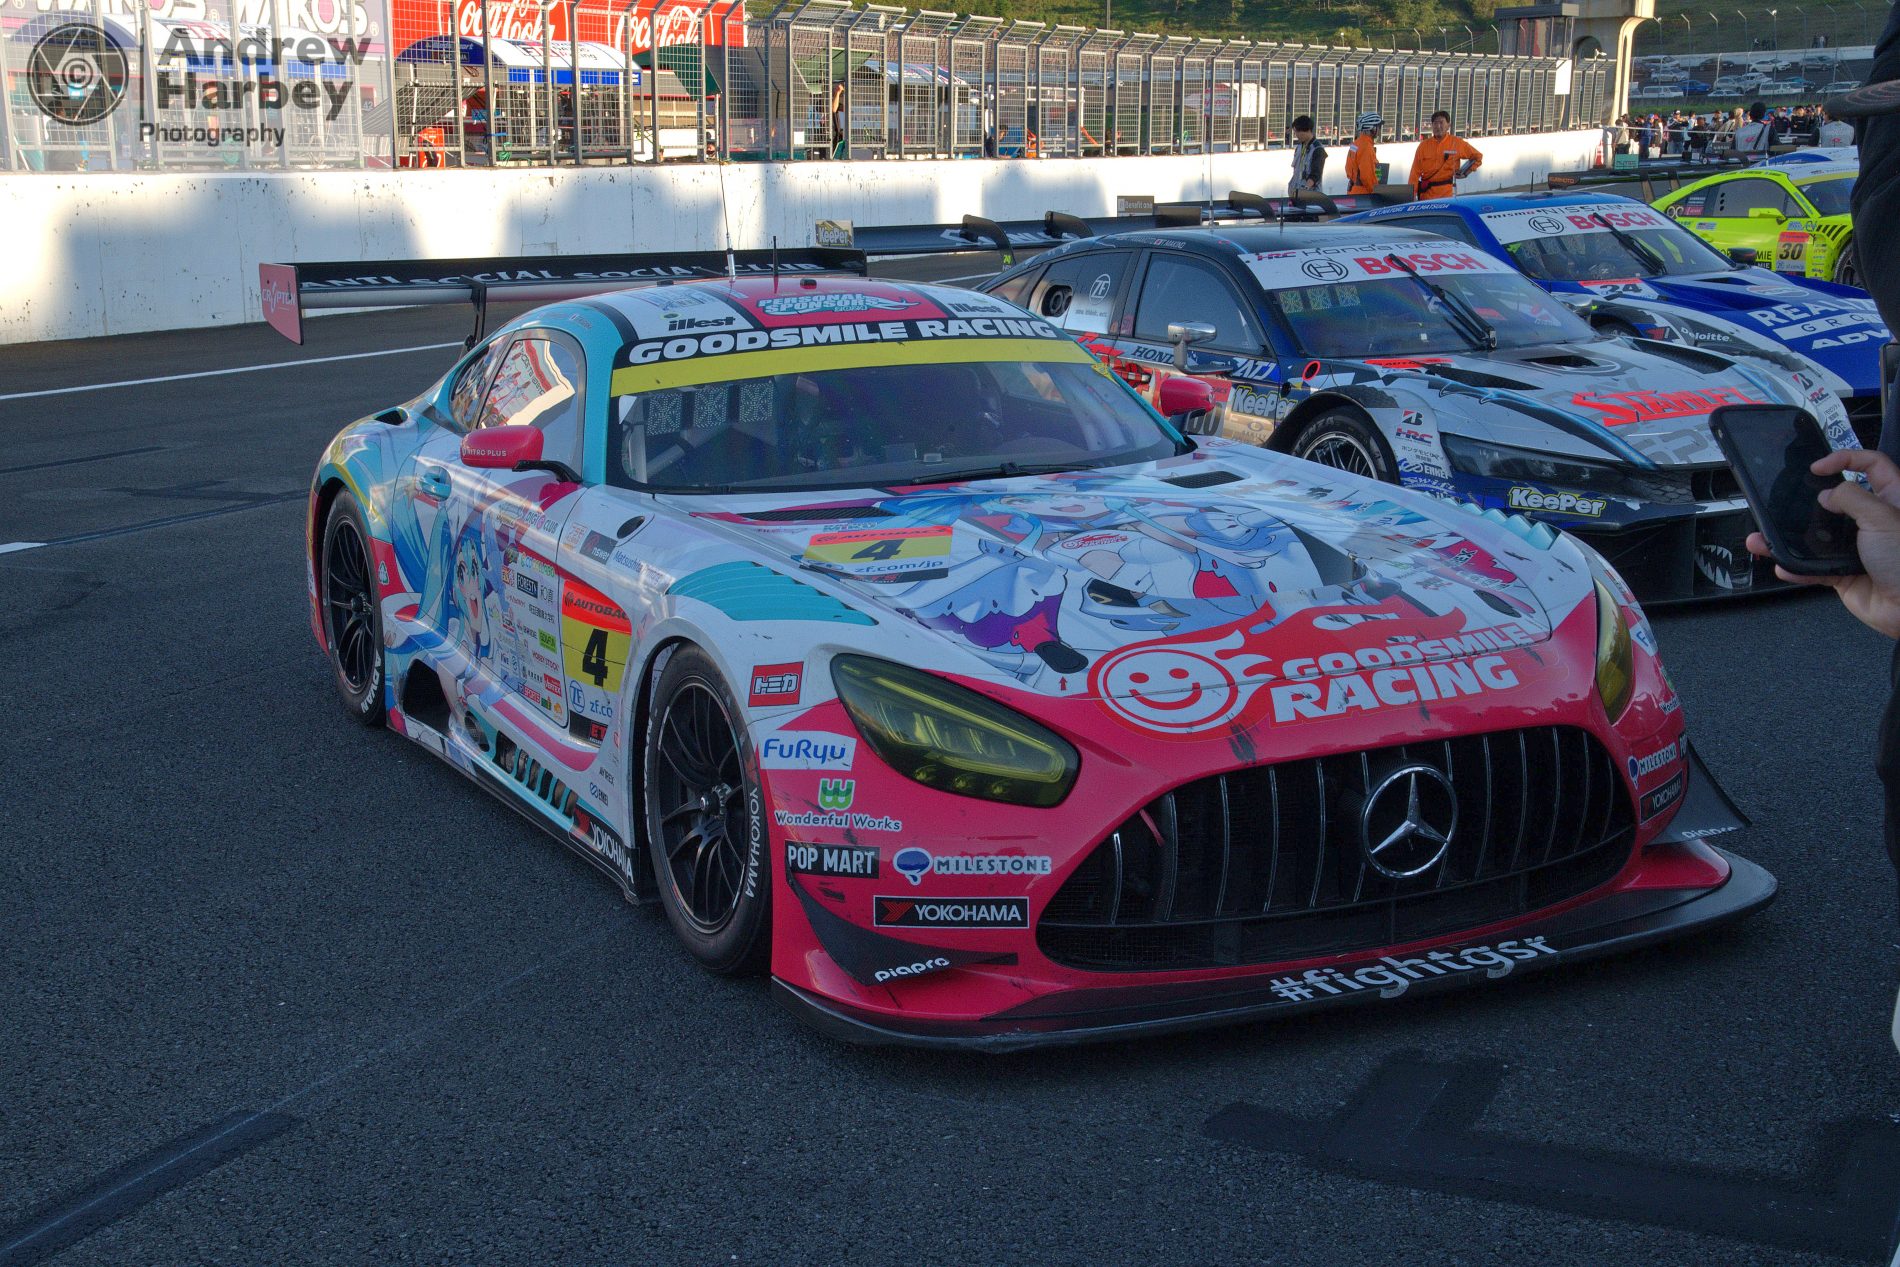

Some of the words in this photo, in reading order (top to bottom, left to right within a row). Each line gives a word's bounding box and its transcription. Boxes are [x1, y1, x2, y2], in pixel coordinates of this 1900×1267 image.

[1542, 203, 1622, 215] NISSAN
[1566, 212, 1663, 230] BOSCH
[1780, 242, 1803, 261] 30
[1354, 252, 1489, 276] BOSCH
[301, 275, 400, 290] ANTI
[668, 315, 737, 331] illest
[628, 321, 910, 365] GOODSMILE
[913, 319, 1057, 341] RACING
[1812, 328, 1890, 350] ADV
[1395, 427, 1433, 445] HRC
[1508, 488, 1606, 518] KeePer
[850, 539, 907, 561] 4
[854, 560, 944, 575] zf.com/jp
[582, 628, 609, 688] 4
[1280, 622, 1540, 679] GOODSMILE
[753, 671, 799, 696] トミカ
[1268, 655, 1521, 724] RACING
[763, 738, 847, 765] FuRyu
[775, 811, 850, 829] Wonderful
[852, 814, 902, 833] Works
[590, 822, 635, 884] YOKOHAMA
[745, 787, 760, 898] YOKOHAMA
[788, 845, 818, 868] POP
[823, 847, 876, 875] MART
[933, 856, 1050, 874] MILESTONE
[914, 904, 1022, 922] YOKOHAMA
[874, 957, 951, 983] piapro
[1269, 935, 1558, 999] #fightgsr
